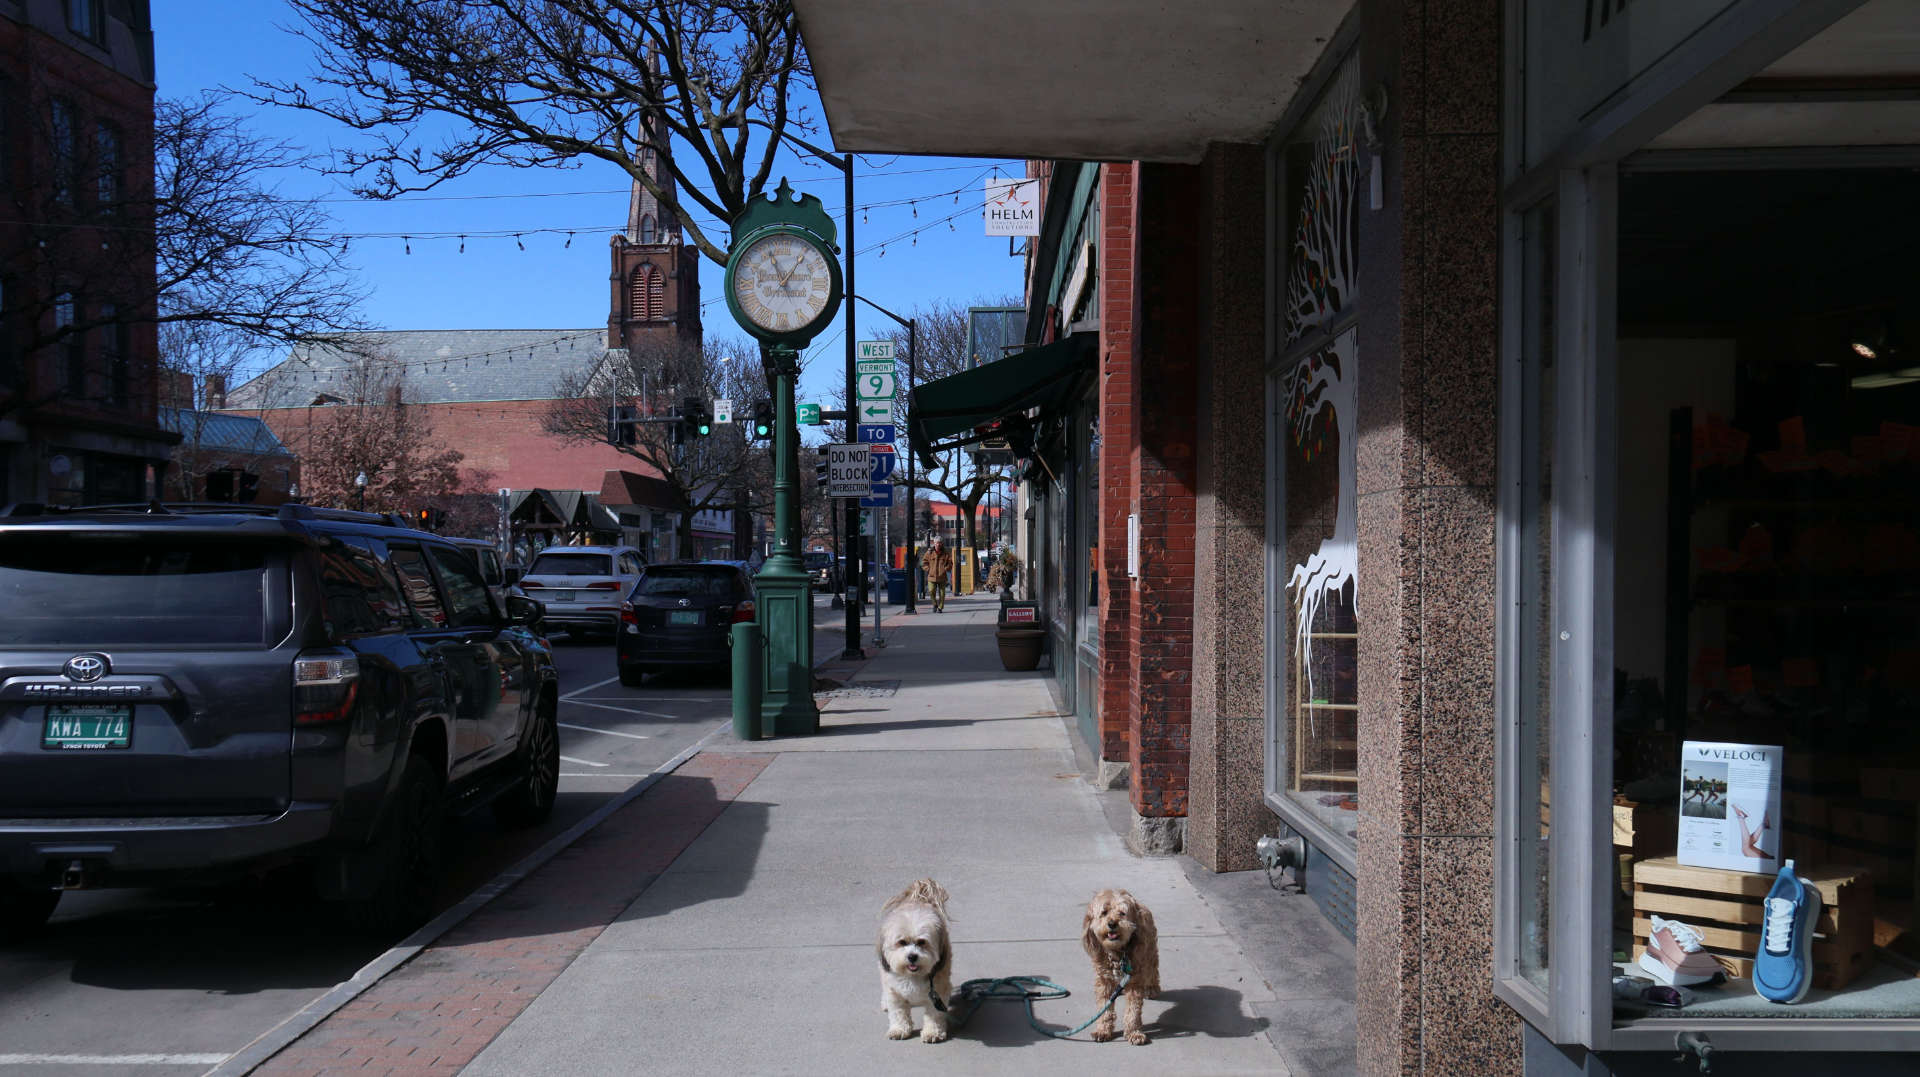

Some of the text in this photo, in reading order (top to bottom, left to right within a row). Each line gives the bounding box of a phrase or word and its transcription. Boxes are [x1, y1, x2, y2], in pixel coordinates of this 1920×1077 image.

[992, 209, 1033, 220] HELM
[863, 344, 890, 356] WEST
[860, 364, 893, 372] VERMONT
[870, 376, 883, 395] 9
[800, 408, 809, 421] P
[867, 428, 884, 440] TO
[832, 450, 868, 463] DO NOT
[870, 456, 886, 472] 91
[832, 468, 868, 480] BLOCK
[830, 484, 868, 492] INTERSECTION
[50, 716, 124, 736] KWA 774
[1714, 750, 1767, 761] VELOCI
